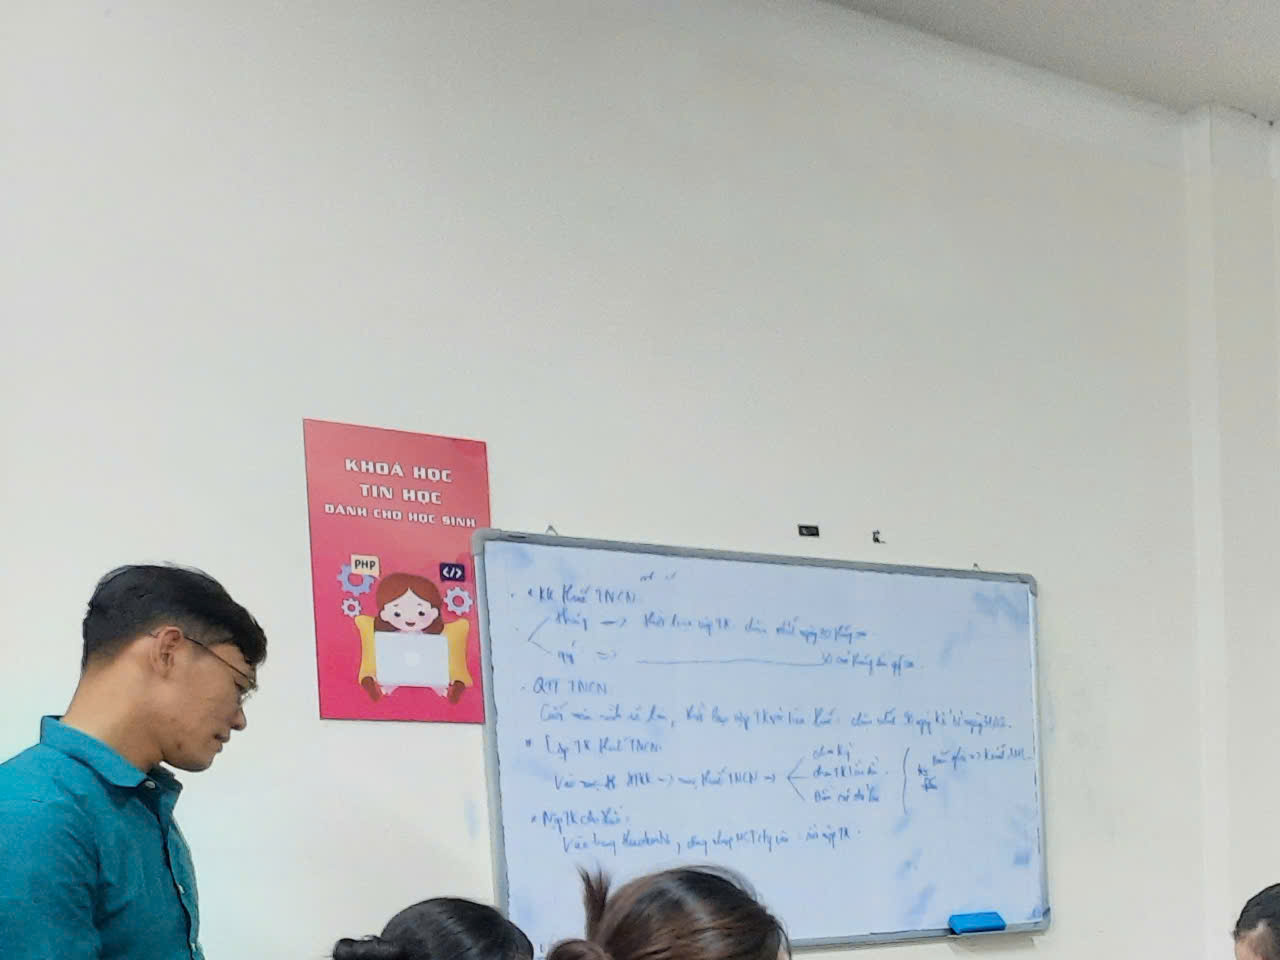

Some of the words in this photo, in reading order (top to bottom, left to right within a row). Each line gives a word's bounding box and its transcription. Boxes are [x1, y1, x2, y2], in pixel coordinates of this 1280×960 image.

[412, 466, 453, 483] HỌC
[360, 484, 393, 500] TIN
[402, 489, 442, 504] HỌC
[374, 508, 402, 521] CHO
[441, 515, 476, 528] SINH
[354, 559, 376, 571] PHP
